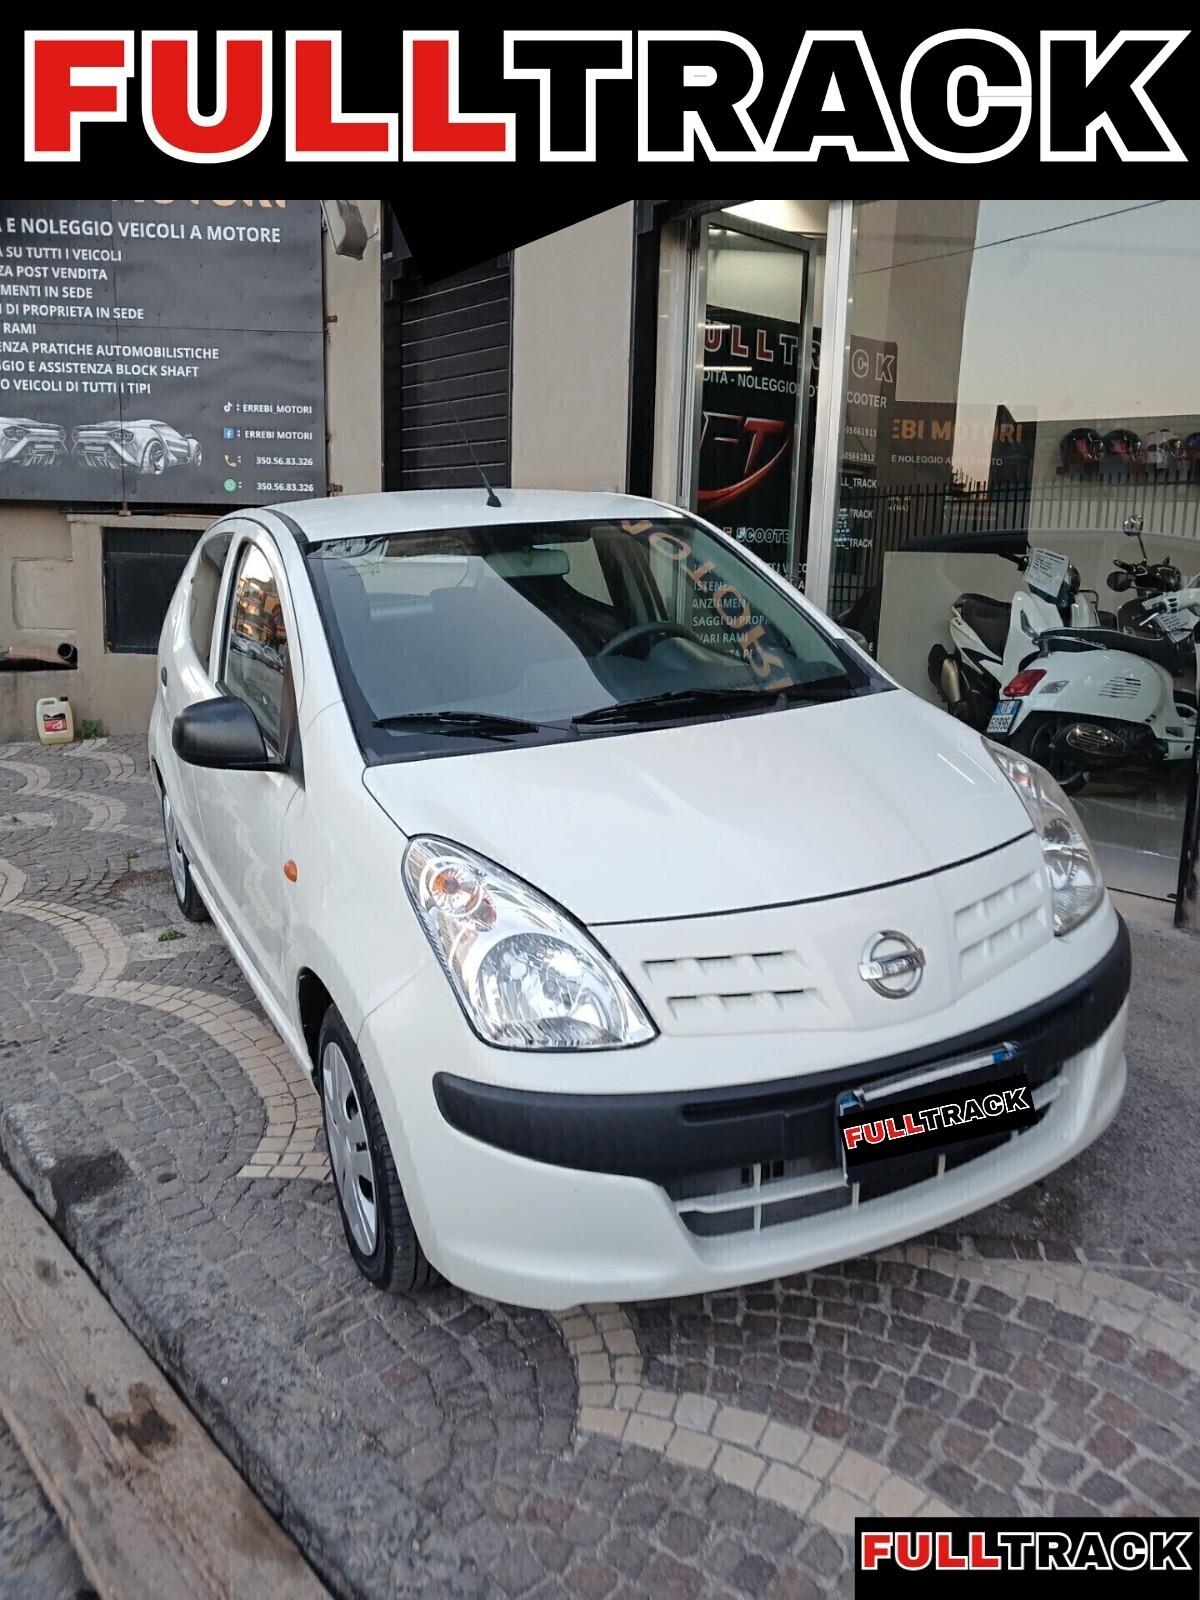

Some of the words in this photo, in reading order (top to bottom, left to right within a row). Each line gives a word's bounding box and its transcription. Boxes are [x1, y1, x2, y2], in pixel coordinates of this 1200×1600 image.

[7, 217, 16, 233] E
[21, 218, 113, 236] NOLEGGIO
[118, 222, 185, 239] VEICOLI
[190, 225, 202, 239] A
[207, 226, 281, 243] MOTORE
[6, 246, 22, 258] SU
[26, 247, 62, 259] TUTTI
[65, 248, 69, 260] I
[72, 248, 122, 262] VEICOLI
[17, 266, 49, 278] POST
[52, 267, 108, 281] VENDITA
[0, 284, 41, 297] MENTI
[45, 286, 58, 297] IN
[62, 287, 93, 299] SEDE
[6, 303, 19, 315] DI
[23, 304, 93, 318] PROPRIETA
[96, 307, 110, 318] IN
[113, 307, 144, 319] SEDE
[3, 322, 37, 335] RAMI
[32, 342, 93, 355] PRATICHE
[96, 344, 219, 359] AUTOMOBILISTICHE
[29, 361, 35, 372] E
[39, 361, 113, 375] ASSISTENZA
[116, 364, 158, 376] BLOCK
[160, 365, 199, 377] SHAFT
[13, 379, 62, 391] VEICOLI
[66, 381, 78, 392] DI
[82, 381, 117, 393] TUTTI
[120, 382, 124, 393] I
[127, 382, 151, 394] TIPI
[738, 373, 797, 394] NOLEGGIO
[243, 403, 312, 414] ERREBI_MOTORI
[244, 430, 275, 439] ERREBI
[277, 431, 313, 440] MOTORI
[256, 456, 313, 466] 350.56.83.326
[256, 482, 314, 492] 350.56.83.326
